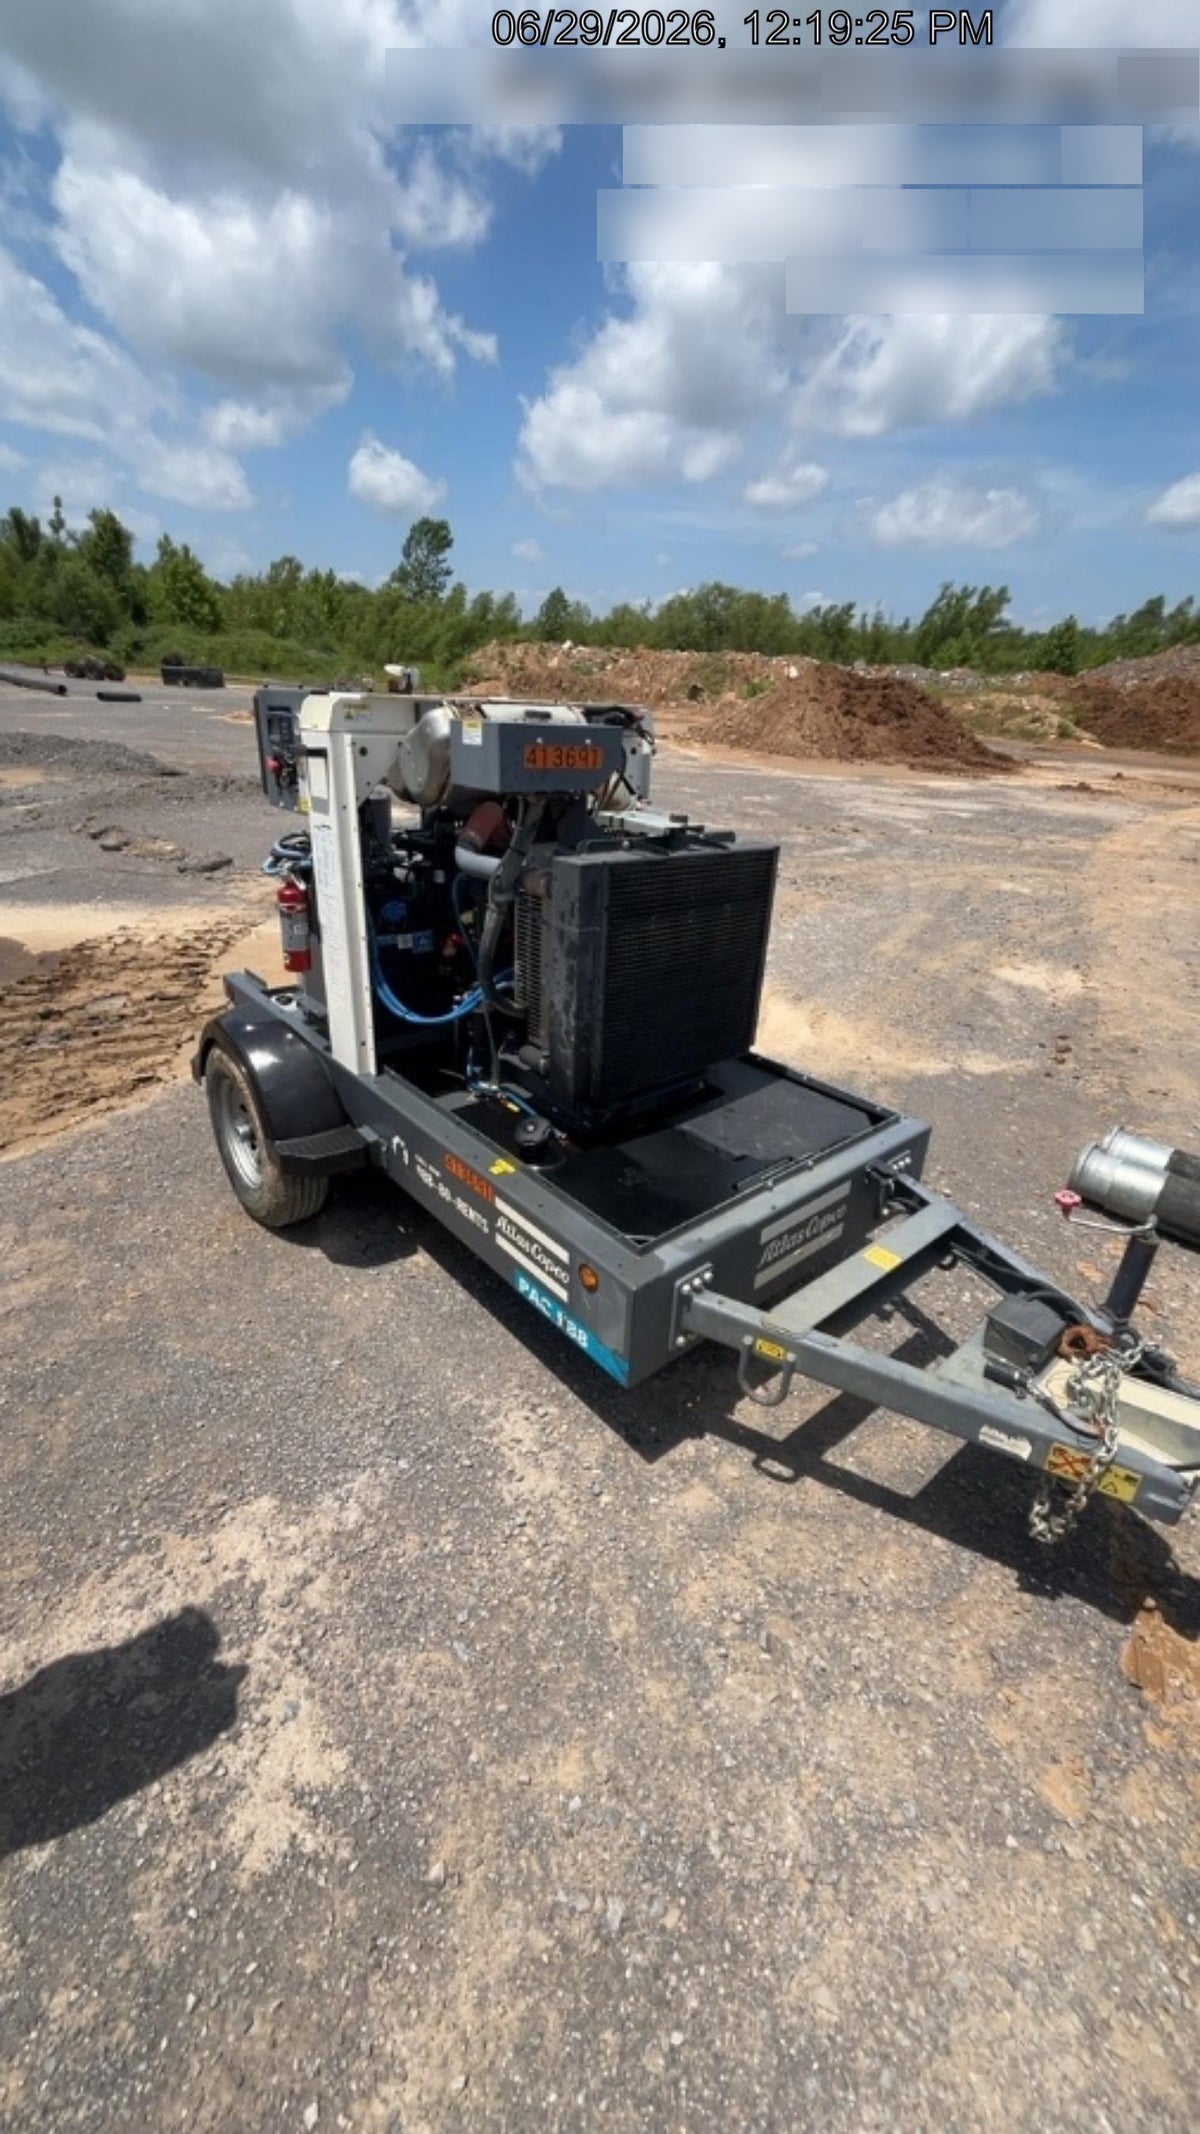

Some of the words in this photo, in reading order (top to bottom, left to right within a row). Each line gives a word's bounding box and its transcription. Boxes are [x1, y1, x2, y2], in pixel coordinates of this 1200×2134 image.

[497, 1215, 530, 1254] Atlas
[530, 1244, 570, 1283] Copco
[518, 1276, 553, 1317] PAC
